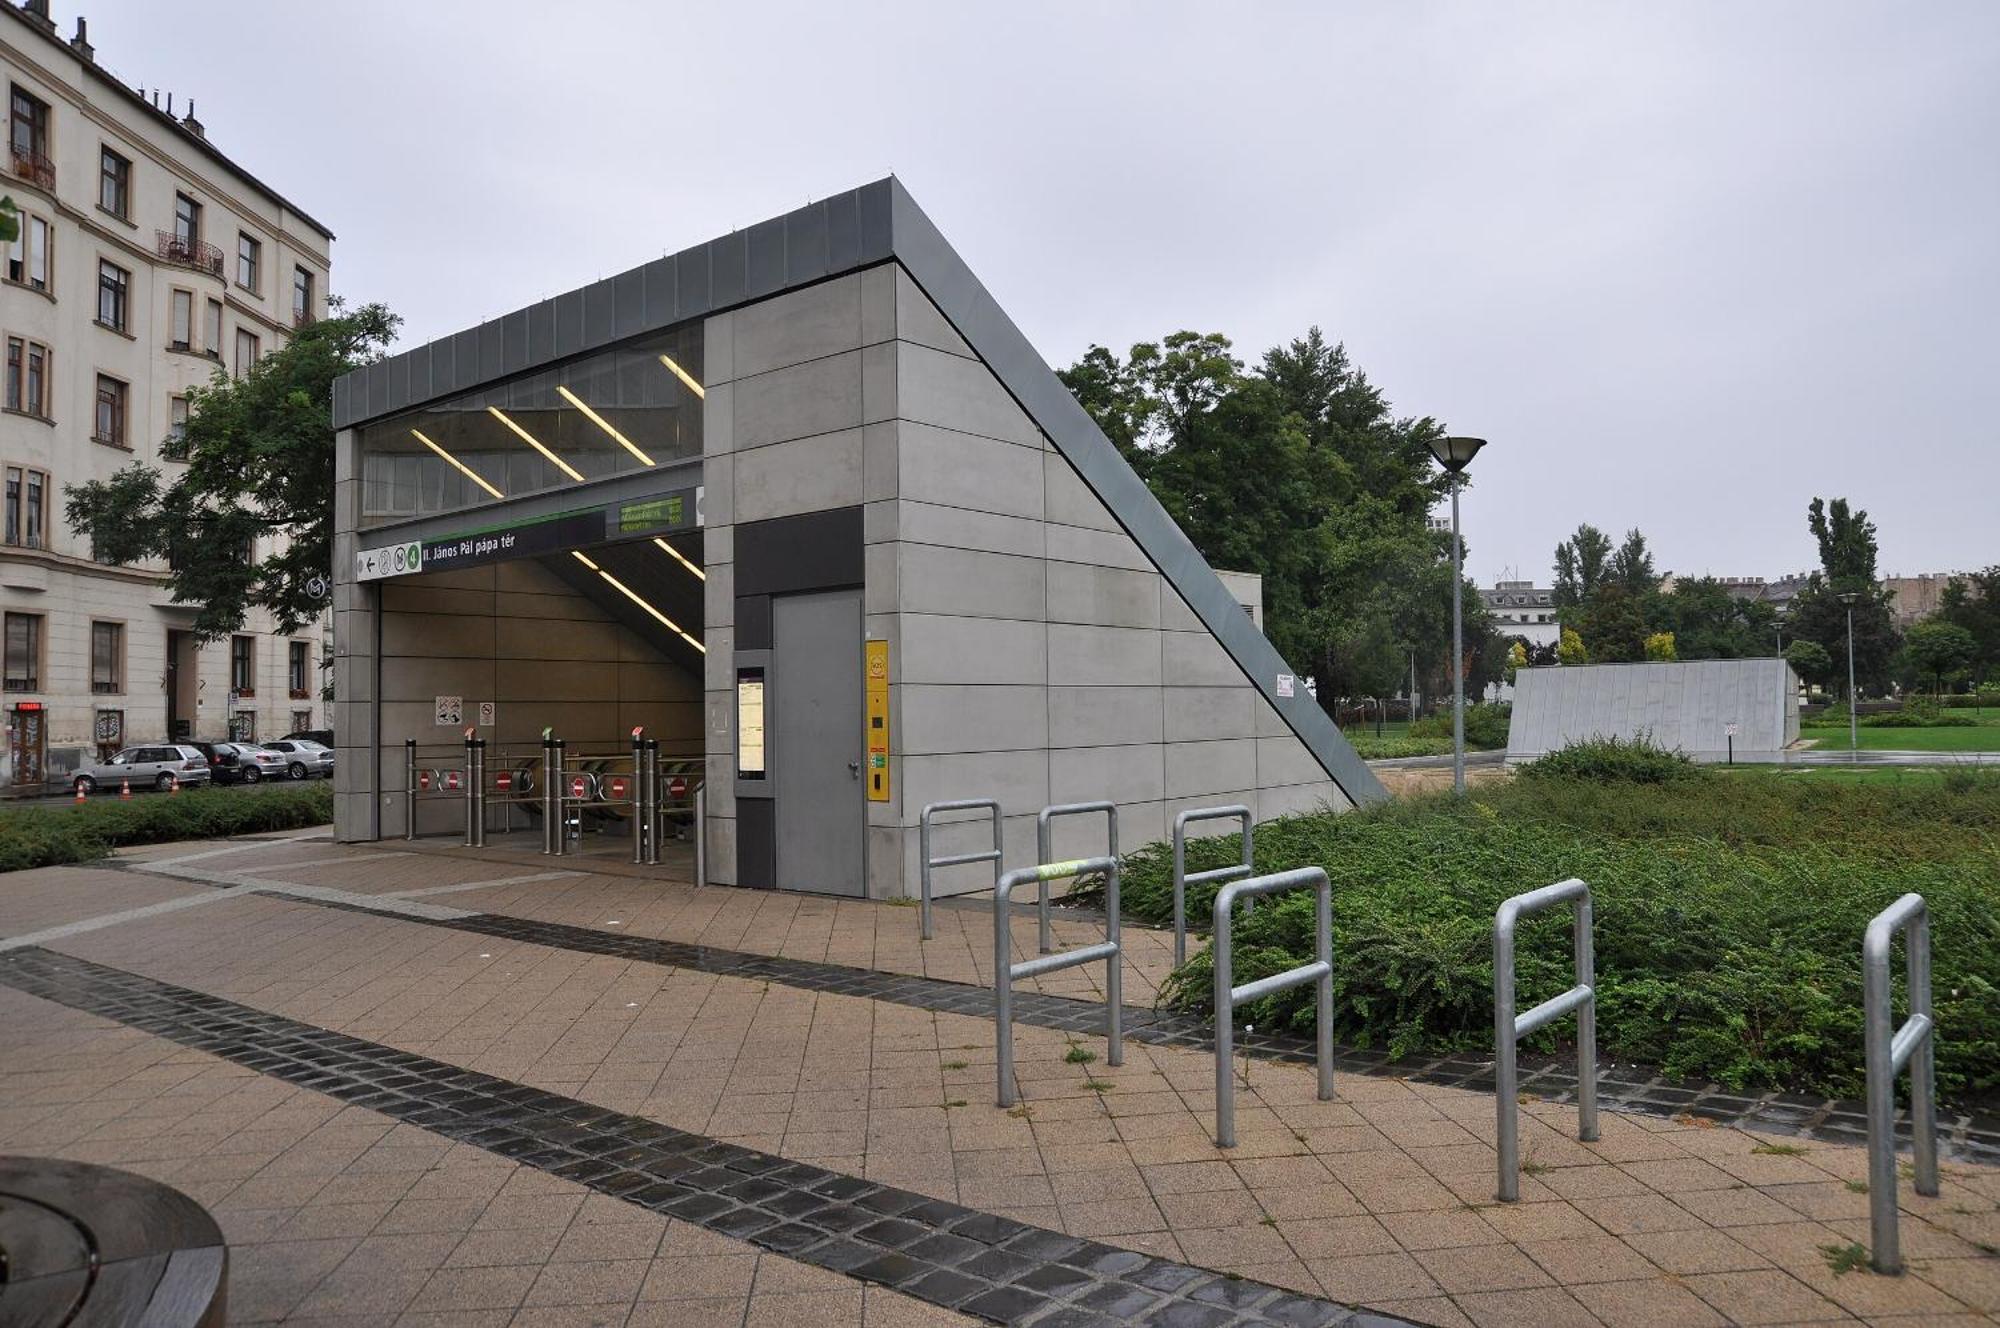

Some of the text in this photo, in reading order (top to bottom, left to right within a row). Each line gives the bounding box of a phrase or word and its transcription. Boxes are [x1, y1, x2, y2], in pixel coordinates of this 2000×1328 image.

[410, 550, 417, 565] 4
[423, 533, 515, 561] II. János Pál pápa tér
